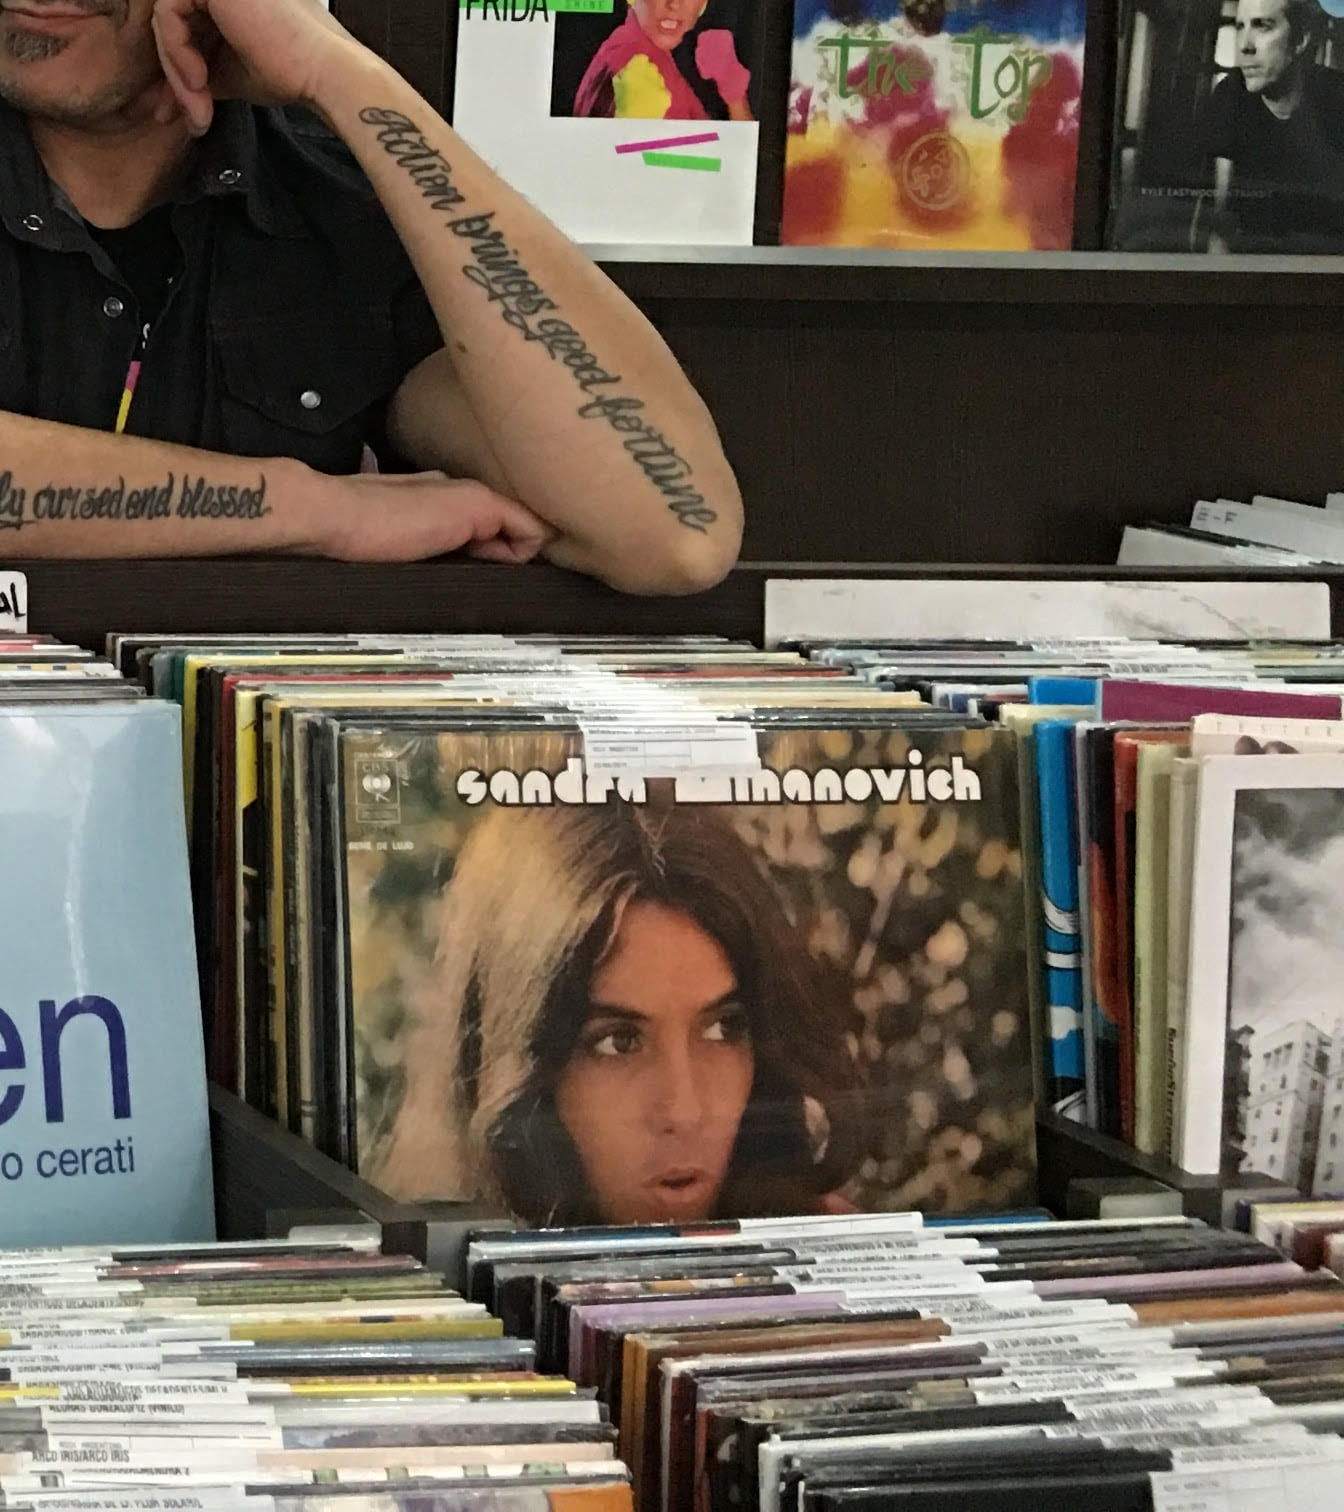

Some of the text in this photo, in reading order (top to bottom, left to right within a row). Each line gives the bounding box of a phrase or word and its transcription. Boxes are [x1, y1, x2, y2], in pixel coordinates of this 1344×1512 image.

[32, 475, 123, 520] cursed
[125, 472, 173, 519] and
[176, 473, 272, 520] blessed
[455, 756, 648, 806] sandra
[36, 1136, 136, 1181] cerati
